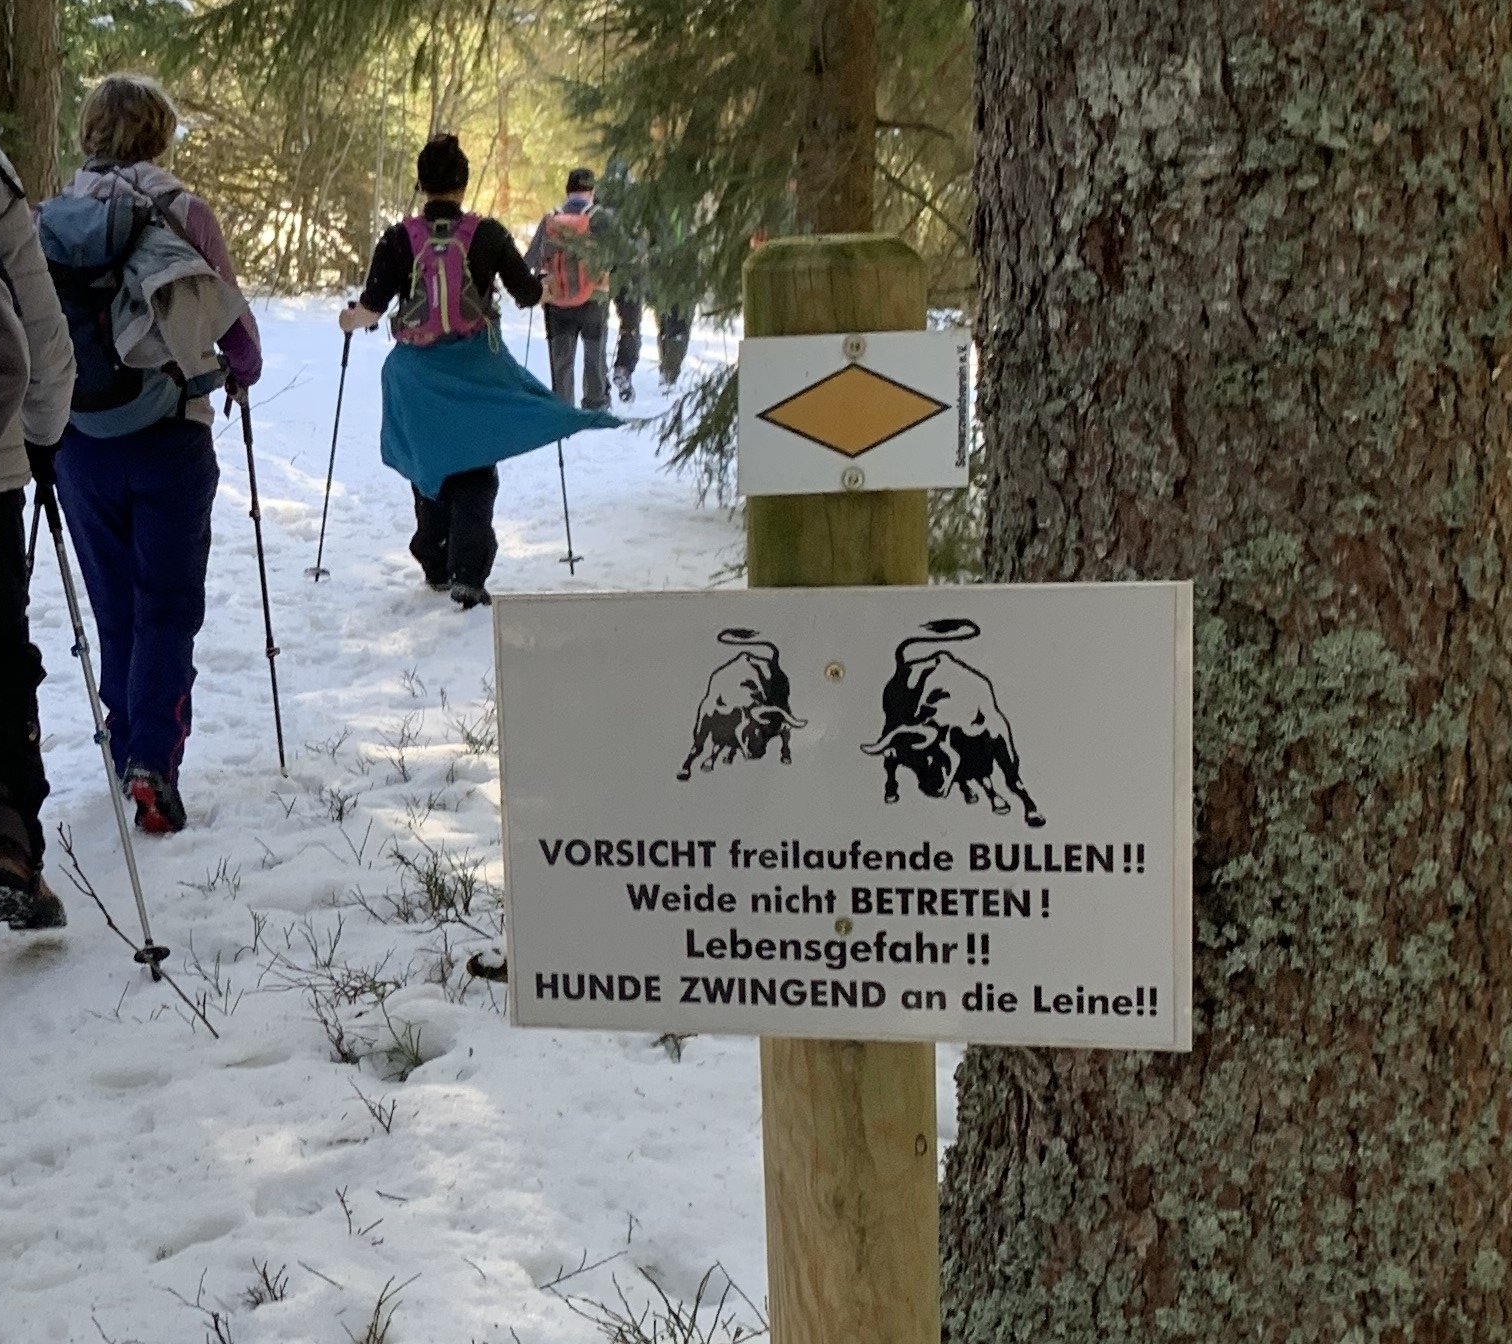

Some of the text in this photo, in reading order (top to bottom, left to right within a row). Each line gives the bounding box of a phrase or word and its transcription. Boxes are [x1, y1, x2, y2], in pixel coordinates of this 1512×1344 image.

[538, 838, 1146, 875] VORSICHT freilaufende BULLEN!!
[625, 882, 1051, 918] Weide nicht BETRETEN!
[685, 928, 991, 970] Lebensgefahr!!
[534, 972, 1160, 1018] HUNDE ZWINGEND an die Leine!!
